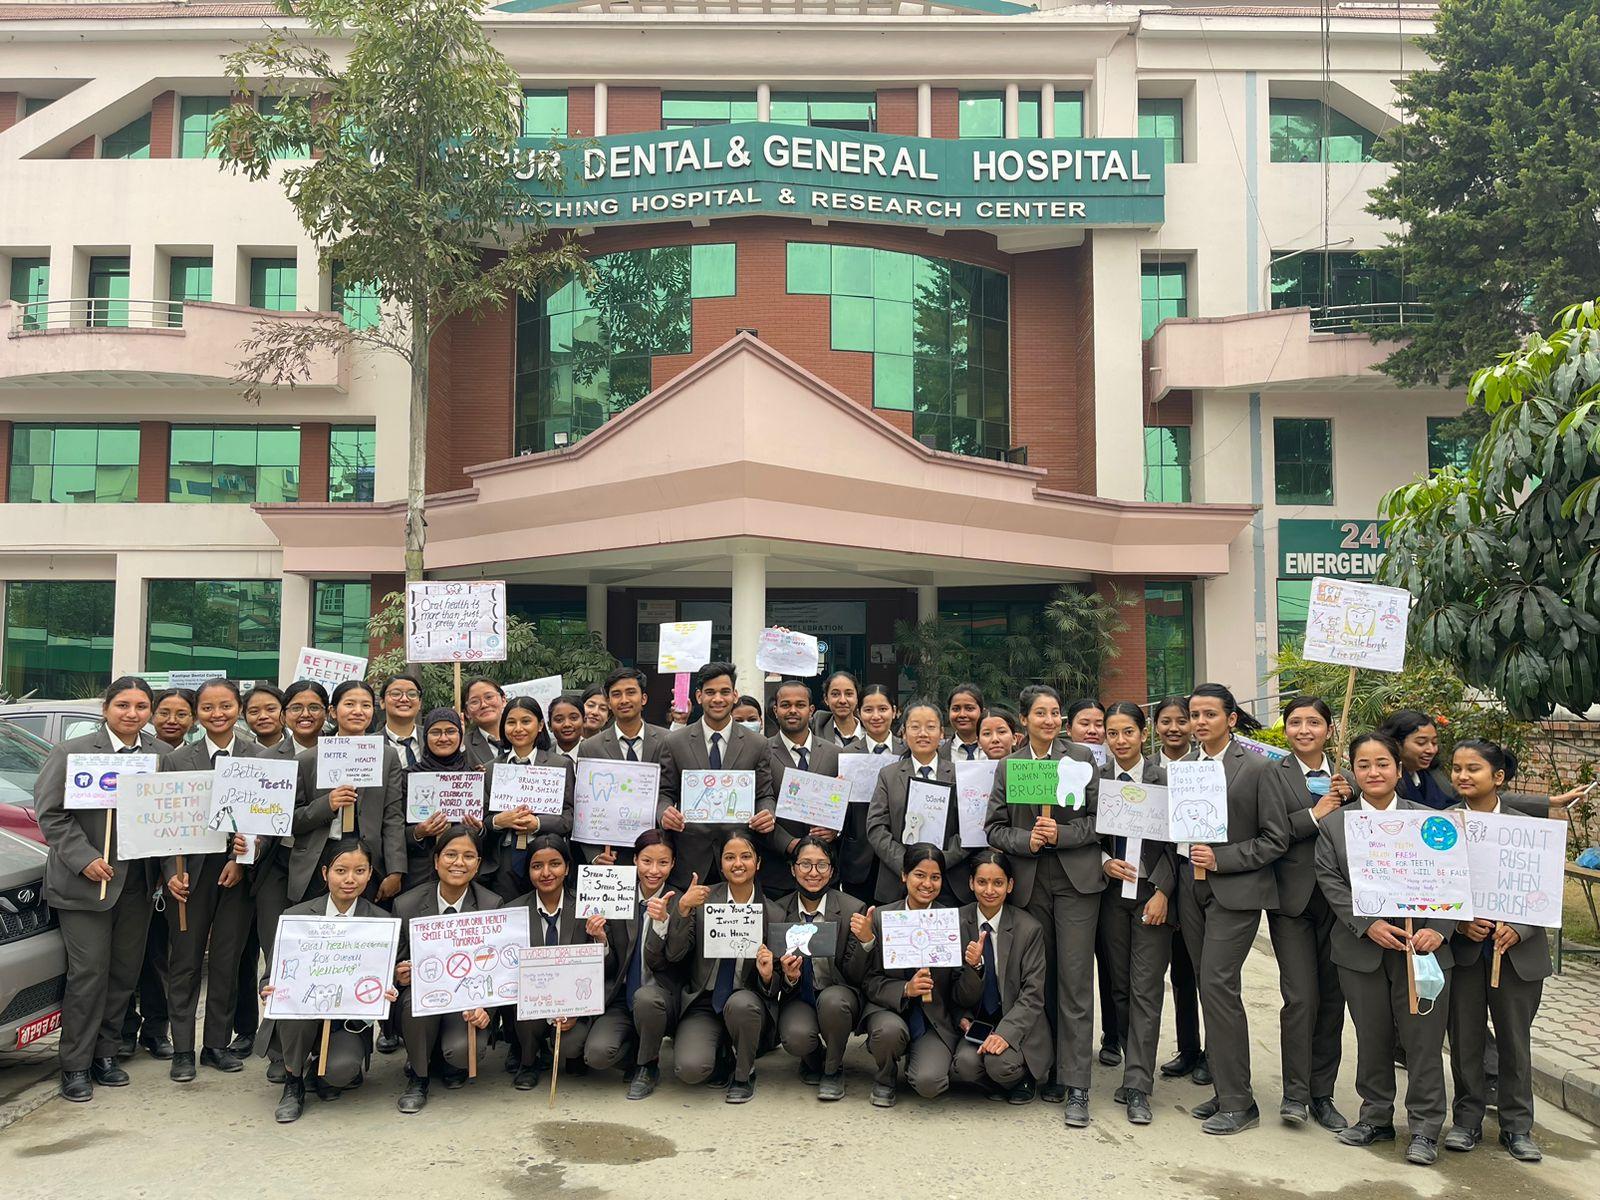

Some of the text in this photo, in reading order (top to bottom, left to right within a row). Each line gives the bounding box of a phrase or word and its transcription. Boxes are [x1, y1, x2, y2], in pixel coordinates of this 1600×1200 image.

[584, 139, 722, 182] DENTAL
[727, 135, 750, 175] &
[763, 134, 938, 181] GENERAL
[973, 149, 1151, 182] HOSPITAL
[631, 187, 762, 213] HOSPITAL
[778, 187, 797, 206] &
[811, 191, 961, 218] RESEARCH
[976, 201, 1087, 219] CENTER
[303, 655, 359, 674] BETTER
[306, 666, 350, 681] TEETH
[222, 761, 268, 779] Better
[1012, 761, 1057, 772] DON'T RUSH
[1017, 770, 1058, 781] WHEN YOU
[136, 781, 184, 797] BRUSH
[258, 778, 293, 790] Teeth
[153, 795, 200, 810] TEETH
[218, 787, 268, 806] Better
[136, 810, 184, 824] CRUSH
[153, 824, 209, 838] CAVITY
[1411, 859, 1435, 868] TEETH
[1498, 848, 1542, 874] RUSH
[1496, 869, 1542, 893] WHEN
[579, 893, 601, 902] HAPPY
[602, 893, 616, 902] ORAL
[1486, 891, 1530, 918] BRUSH
[615, 904, 630, 912] DAY!
[706, 905, 726, 915] OWN
[430, 920, 445, 931] CARE
[445, 919, 456, 929] OF
[743, 916, 756, 925] IN
[421, 930, 442, 942] SMILE
[460, 925, 480, 937] THERE
[481, 924, 491, 933] IS
[491, 924, 503, 934] NO
[709, 929, 727, 939] ORAL
[451, 935, 485, 948] TOMORROW
